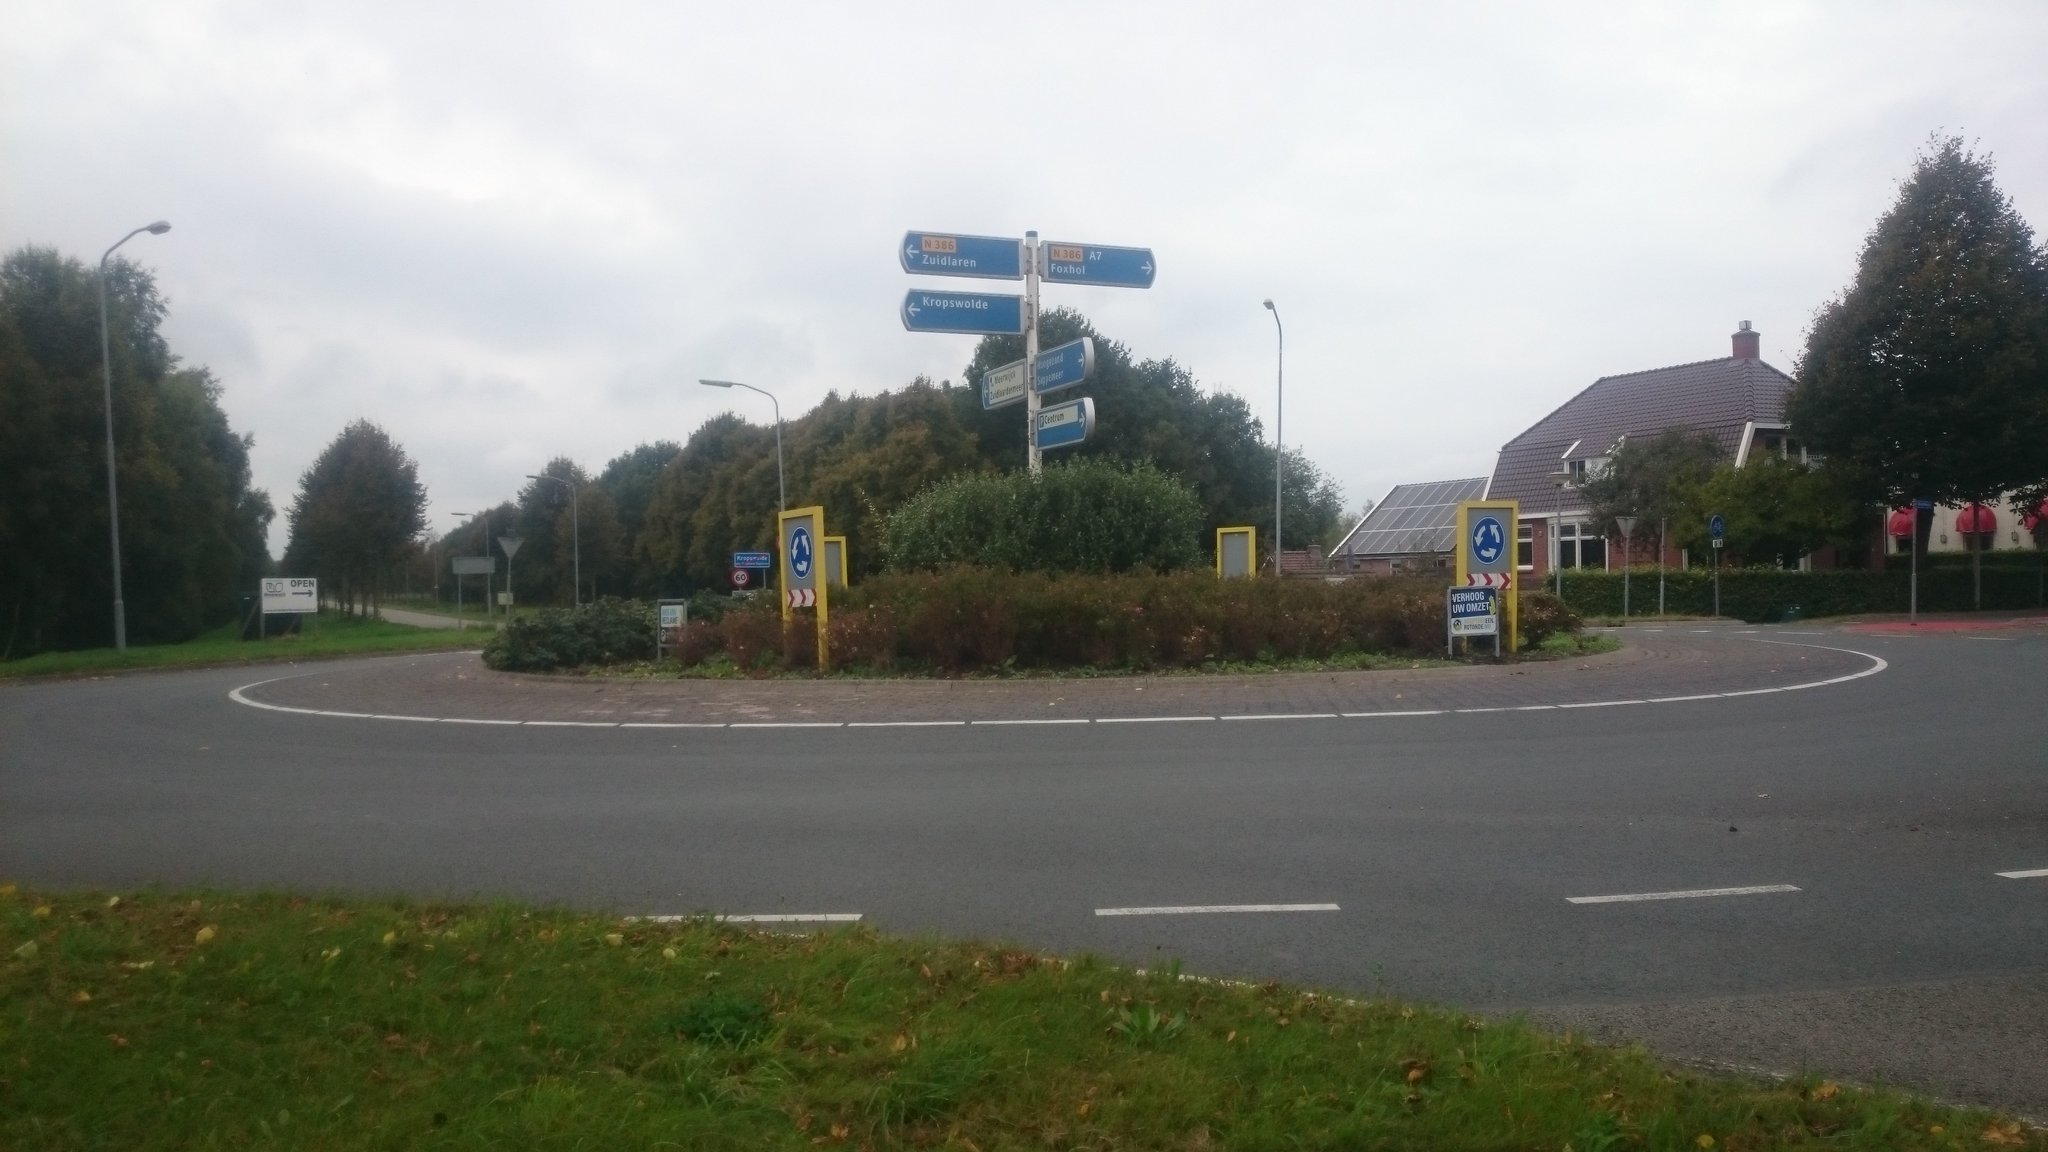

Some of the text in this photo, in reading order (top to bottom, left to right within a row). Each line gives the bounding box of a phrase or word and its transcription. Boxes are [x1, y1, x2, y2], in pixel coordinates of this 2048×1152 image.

[924, 240, 954, 250] N 386
[1053, 248, 1102, 261] N 386 A7
[922, 254, 977, 268] Zuidlaren
[1051, 263, 1085, 275] Foxhol
[922, 296, 989, 309] Kropswolde
[1044, 413, 1064, 425] Centrum
[290, 579, 315, 588] OPEN
[1452, 592, 1485, 602] VERHOOG
[1453, 602, 1490, 613] UW OMZET
